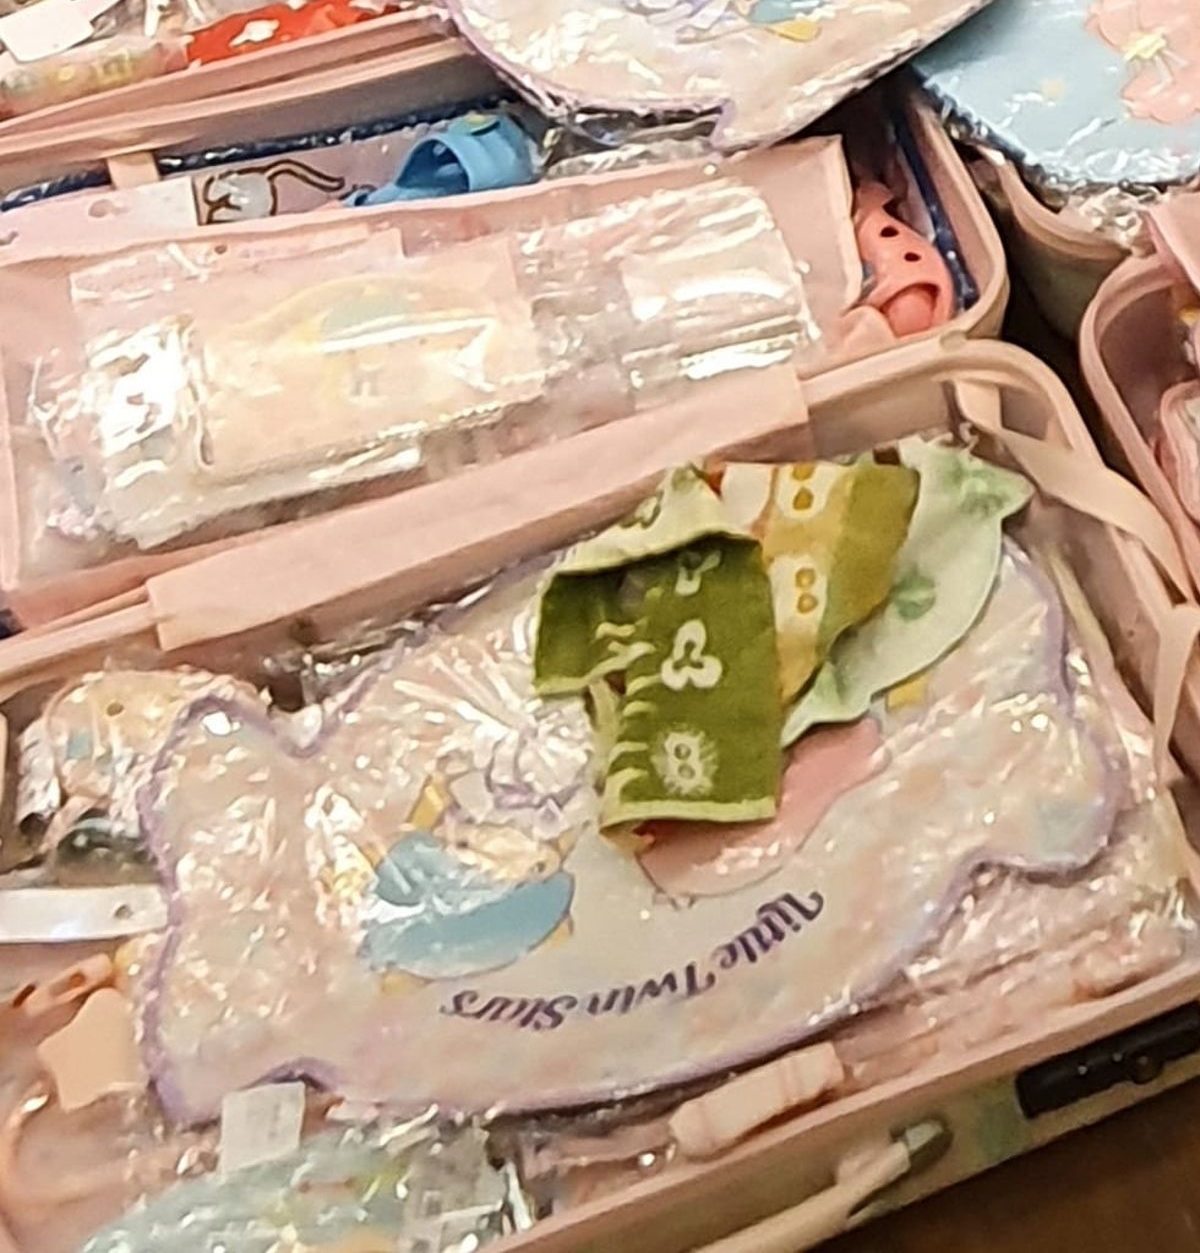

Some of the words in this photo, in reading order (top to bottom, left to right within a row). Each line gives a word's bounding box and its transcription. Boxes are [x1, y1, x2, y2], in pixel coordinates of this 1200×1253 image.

[714, 890, 825, 970] Little
[439, 989, 578, 1032] Stars
[587, 960, 717, 1017] Twin
